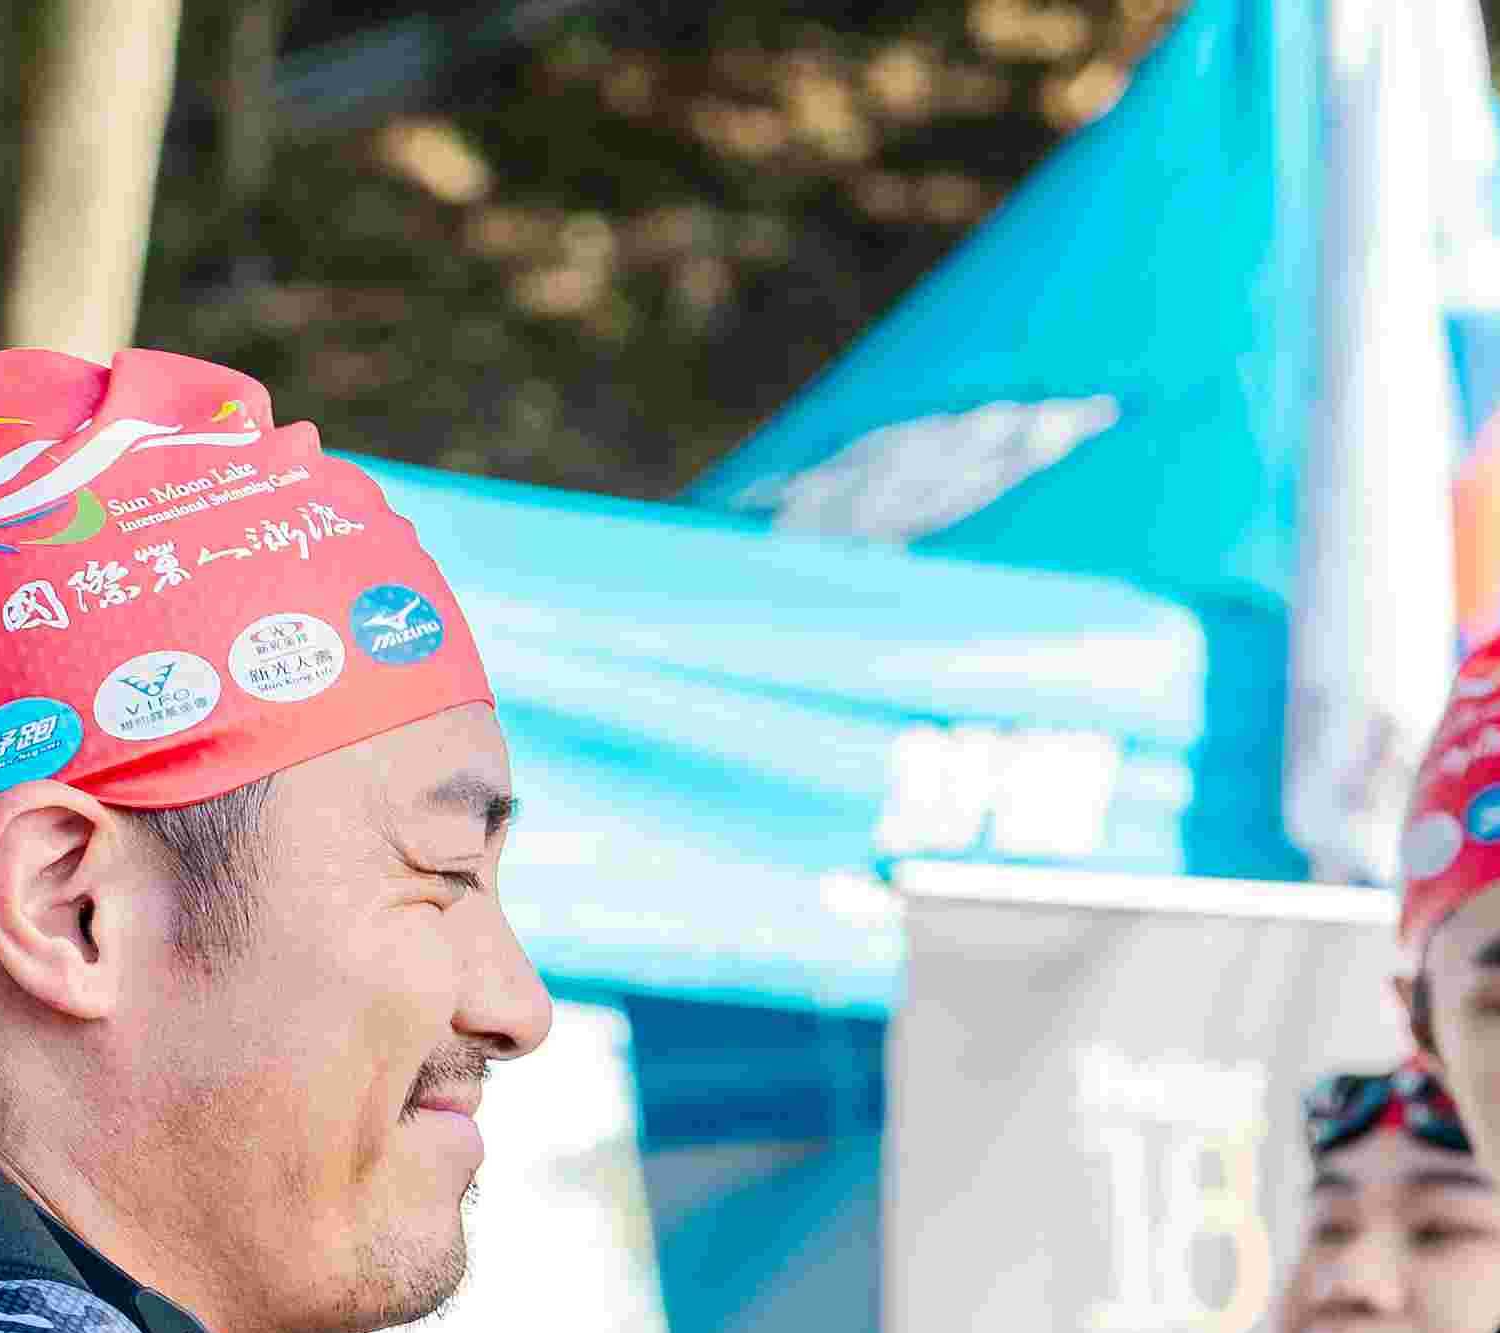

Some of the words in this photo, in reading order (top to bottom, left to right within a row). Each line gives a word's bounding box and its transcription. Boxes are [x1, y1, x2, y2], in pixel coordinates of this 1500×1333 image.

[107, 497, 150, 517] Sun
[150, 477, 212, 505] Moon
[211, 461, 256, 485] Lake
